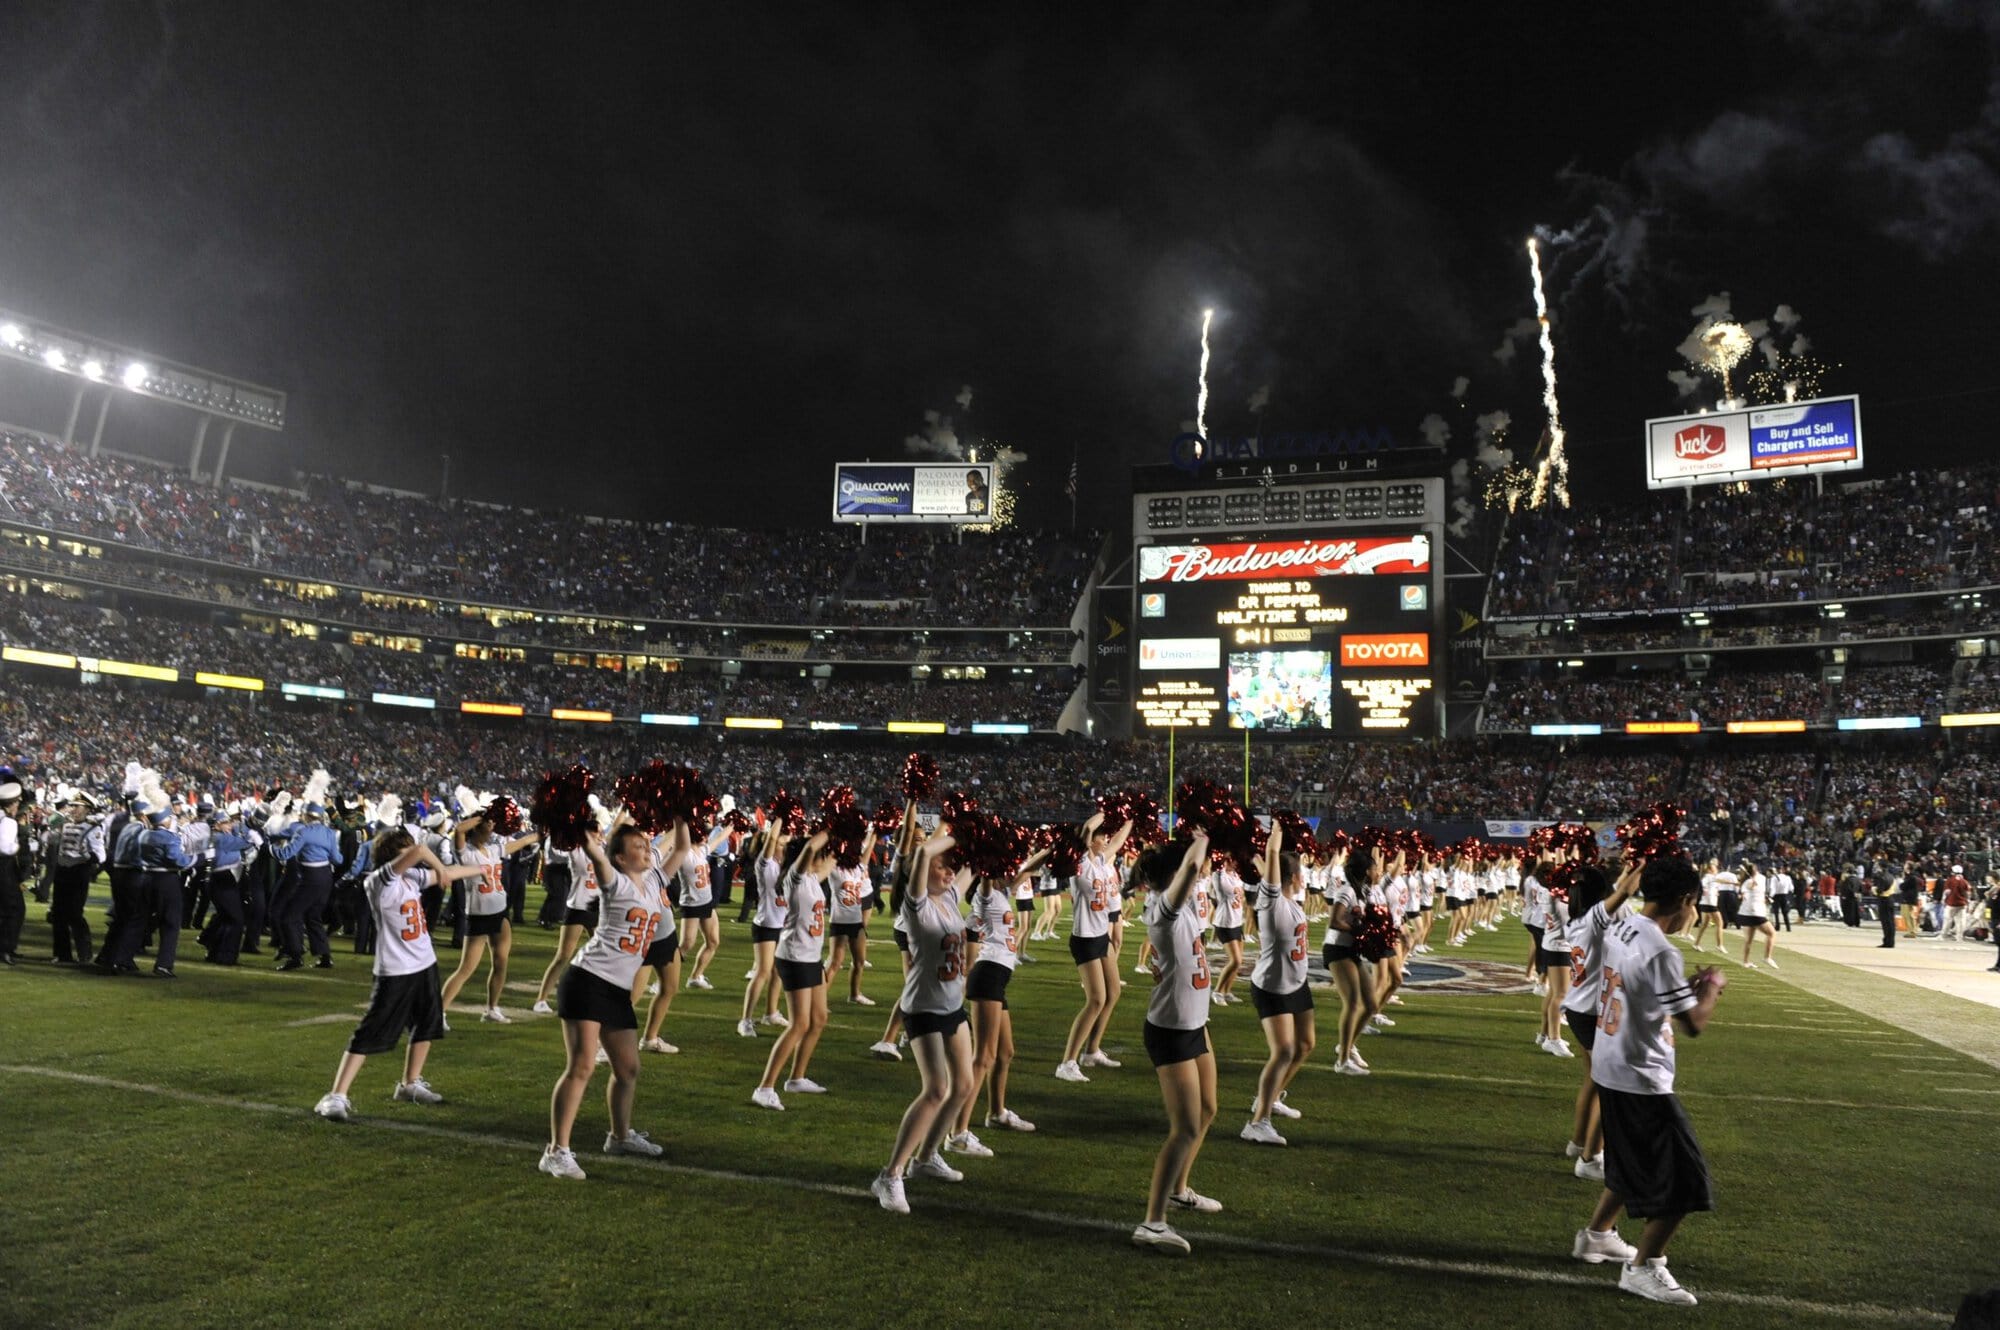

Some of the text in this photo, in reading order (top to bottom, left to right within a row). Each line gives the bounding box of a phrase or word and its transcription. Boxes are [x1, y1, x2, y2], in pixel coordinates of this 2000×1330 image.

[1770, 422, 1833, 440] Buy and Sell
[1676, 427, 1724, 457] Jack
[1757, 433, 1848, 453] Chargers Tickets!
[918, 471, 964, 479] PALOMAR
[1216, 458, 1377, 477] STADIUM
[842, 481, 911, 495] QUALCOMM
[1168, 540, 1357, 582] Budweiser
[1295, 581, 1311, 593] TO
[1238, 594, 1321, 609] DR PEPPER
[1217, 608, 1348, 624] HALFTIME SHOW
[1097, 644, 1127, 656] Sprint
[1160, 651, 1192, 660] Union
[1345, 643, 1424, 659] TOYOTA
